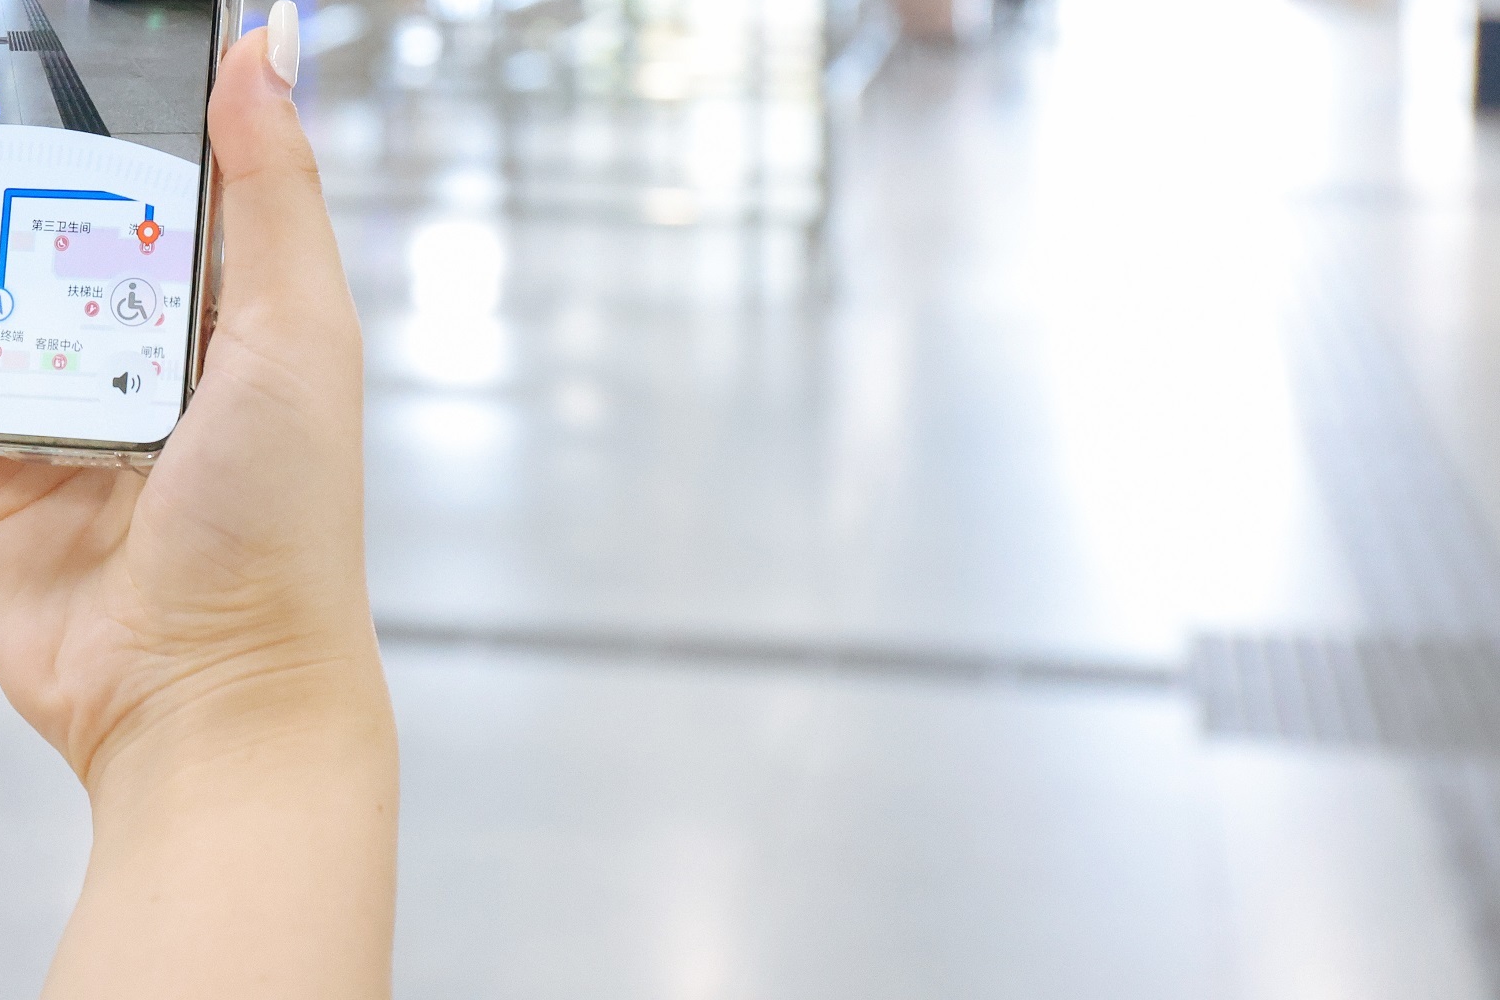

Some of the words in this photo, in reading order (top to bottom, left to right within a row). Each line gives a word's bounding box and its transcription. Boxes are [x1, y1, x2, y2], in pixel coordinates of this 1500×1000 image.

[32, 219, 91, 234] 第三卫生间
[35, 337, 84, 353] 客服中心
